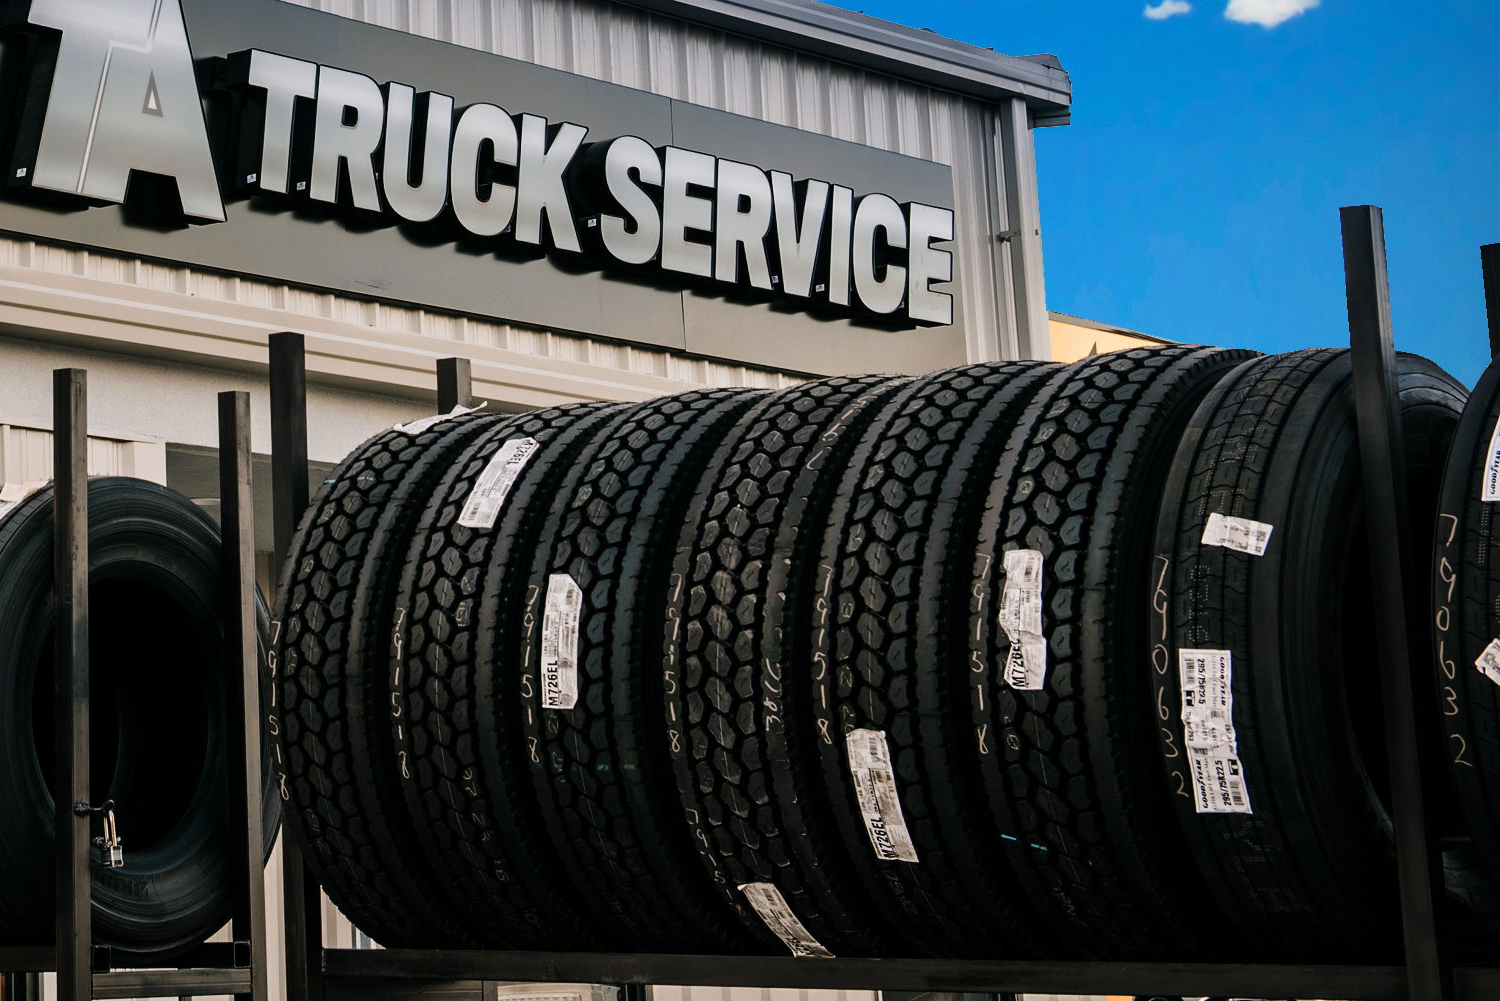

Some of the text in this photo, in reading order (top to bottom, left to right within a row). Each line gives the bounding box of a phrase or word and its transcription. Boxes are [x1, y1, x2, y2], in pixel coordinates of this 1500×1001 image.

[244, 47, 589, 253] TRUCK
[599, 134, 955, 327] SERVICE
[546, 660, 558, 707] M726EL
[1196, 759, 1209, 809] GOODYEAR
[1214, 760, 1232, 806] 295/75R22.5
[871, 817, 899, 859] M726EL
